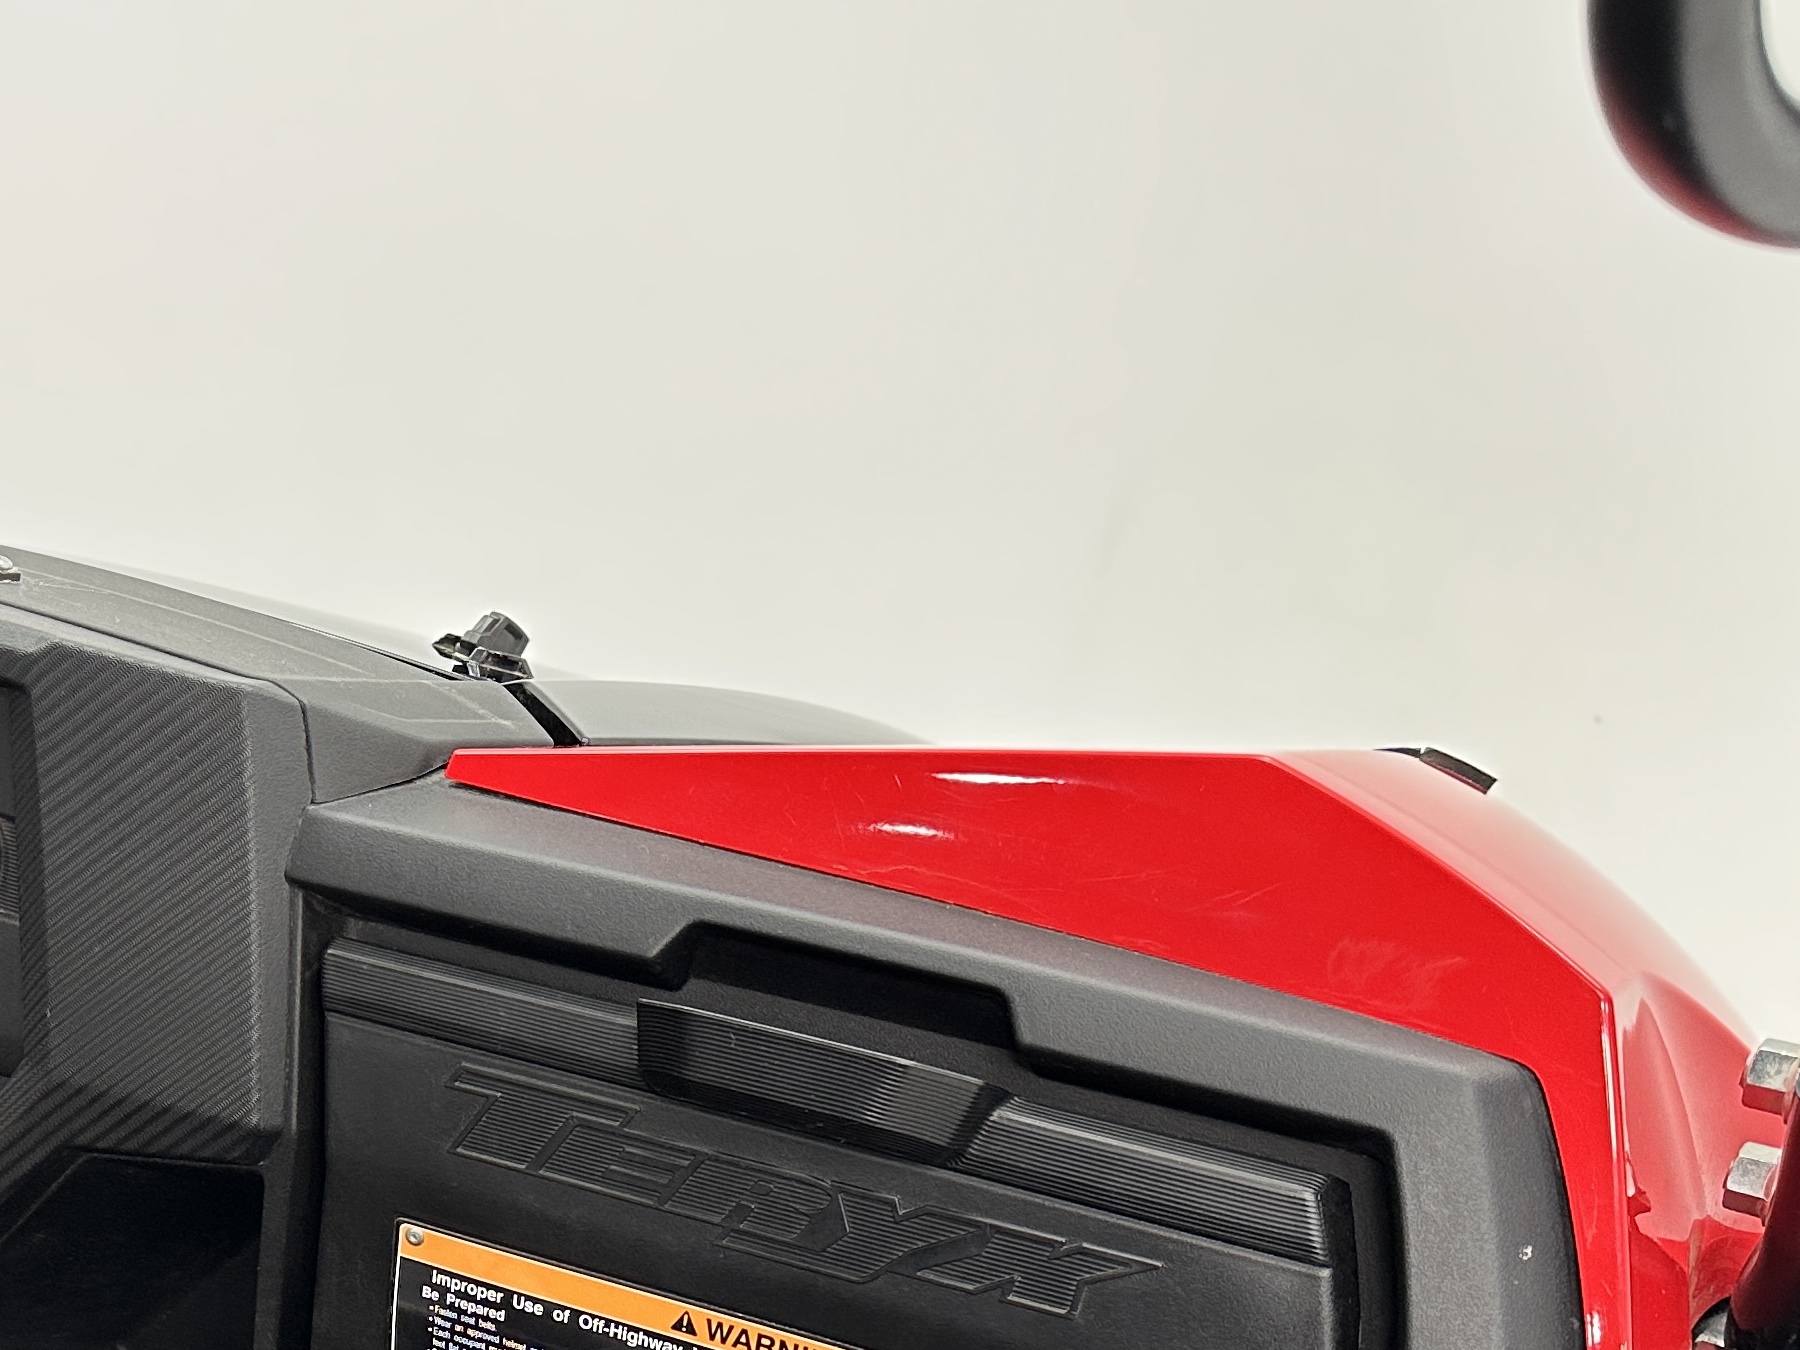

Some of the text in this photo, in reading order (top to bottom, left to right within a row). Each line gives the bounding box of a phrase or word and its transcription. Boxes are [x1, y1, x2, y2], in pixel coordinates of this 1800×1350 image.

[421, 1285, 506, 1322] Be Prepared
[431, 1269, 505, 1304] Improper
[512, 1293, 544, 1316] Use
[552, 1309, 571, 1324] of
